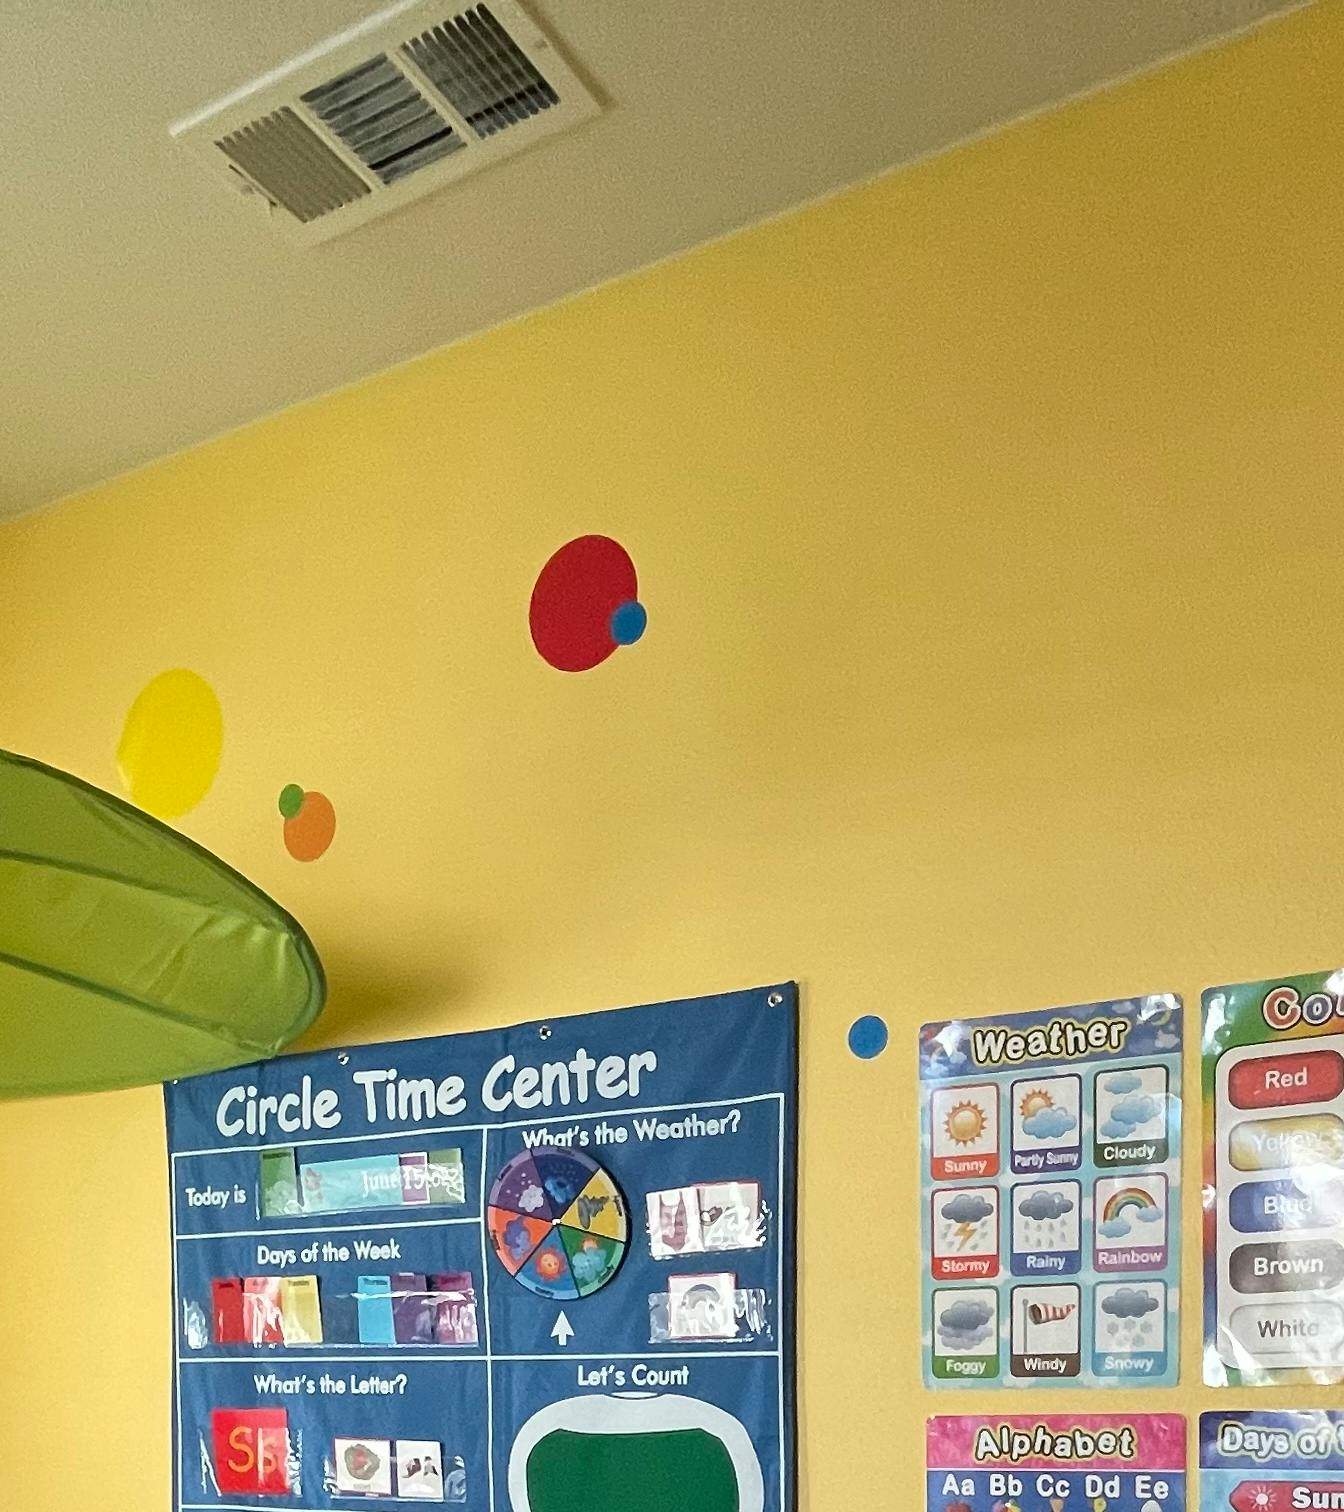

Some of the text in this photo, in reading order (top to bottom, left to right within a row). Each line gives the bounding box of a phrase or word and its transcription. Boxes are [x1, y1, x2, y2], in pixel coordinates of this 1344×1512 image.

[972, 1018, 1129, 1064] Weather
[1265, 1066, 1309, 1090] Red
[216, 1048, 657, 1137] Circle Time Center
[522, 1109, 741, 1149] What's the Weather?
[1013, 1150, 1079, 1169] Partly Sunny
[1103, 1143, 1156, 1164] Cloudy
[943, 1158, 988, 1176] Sunny
[362, 1169, 399, 1198] June
[402, 1166, 425, 1190] 15
[185, 1184, 247, 1207] Today is
[256, 1237, 403, 1268] Days of the Week
[1026, 1253, 1067, 1272] Rainy
[1097, 1248, 1163, 1266] Rainbow
[941, 1256, 991, 1276] Stormy
[1253, 1256, 1324, 1276] Brown
[1257, 1319, 1320, 1338] White
[945, 1358, 987, 1377] Foggy
[1023, 1356, 1067, 1376] Windy
[1104, 1354, 1155, 1373] Snowy
[253, 1373, 408, 1395] What's the Letter?
[576, 1363, 690, 1387] Let's Count
[975, 1425, 1136, 1461] Alphabet
[1219, 1423, 1290, 1461] Days
[1298, 1425, 1332, 1456] of
[942, 1473, 1170, 1500] Aa Bb Cc Dd Ee
